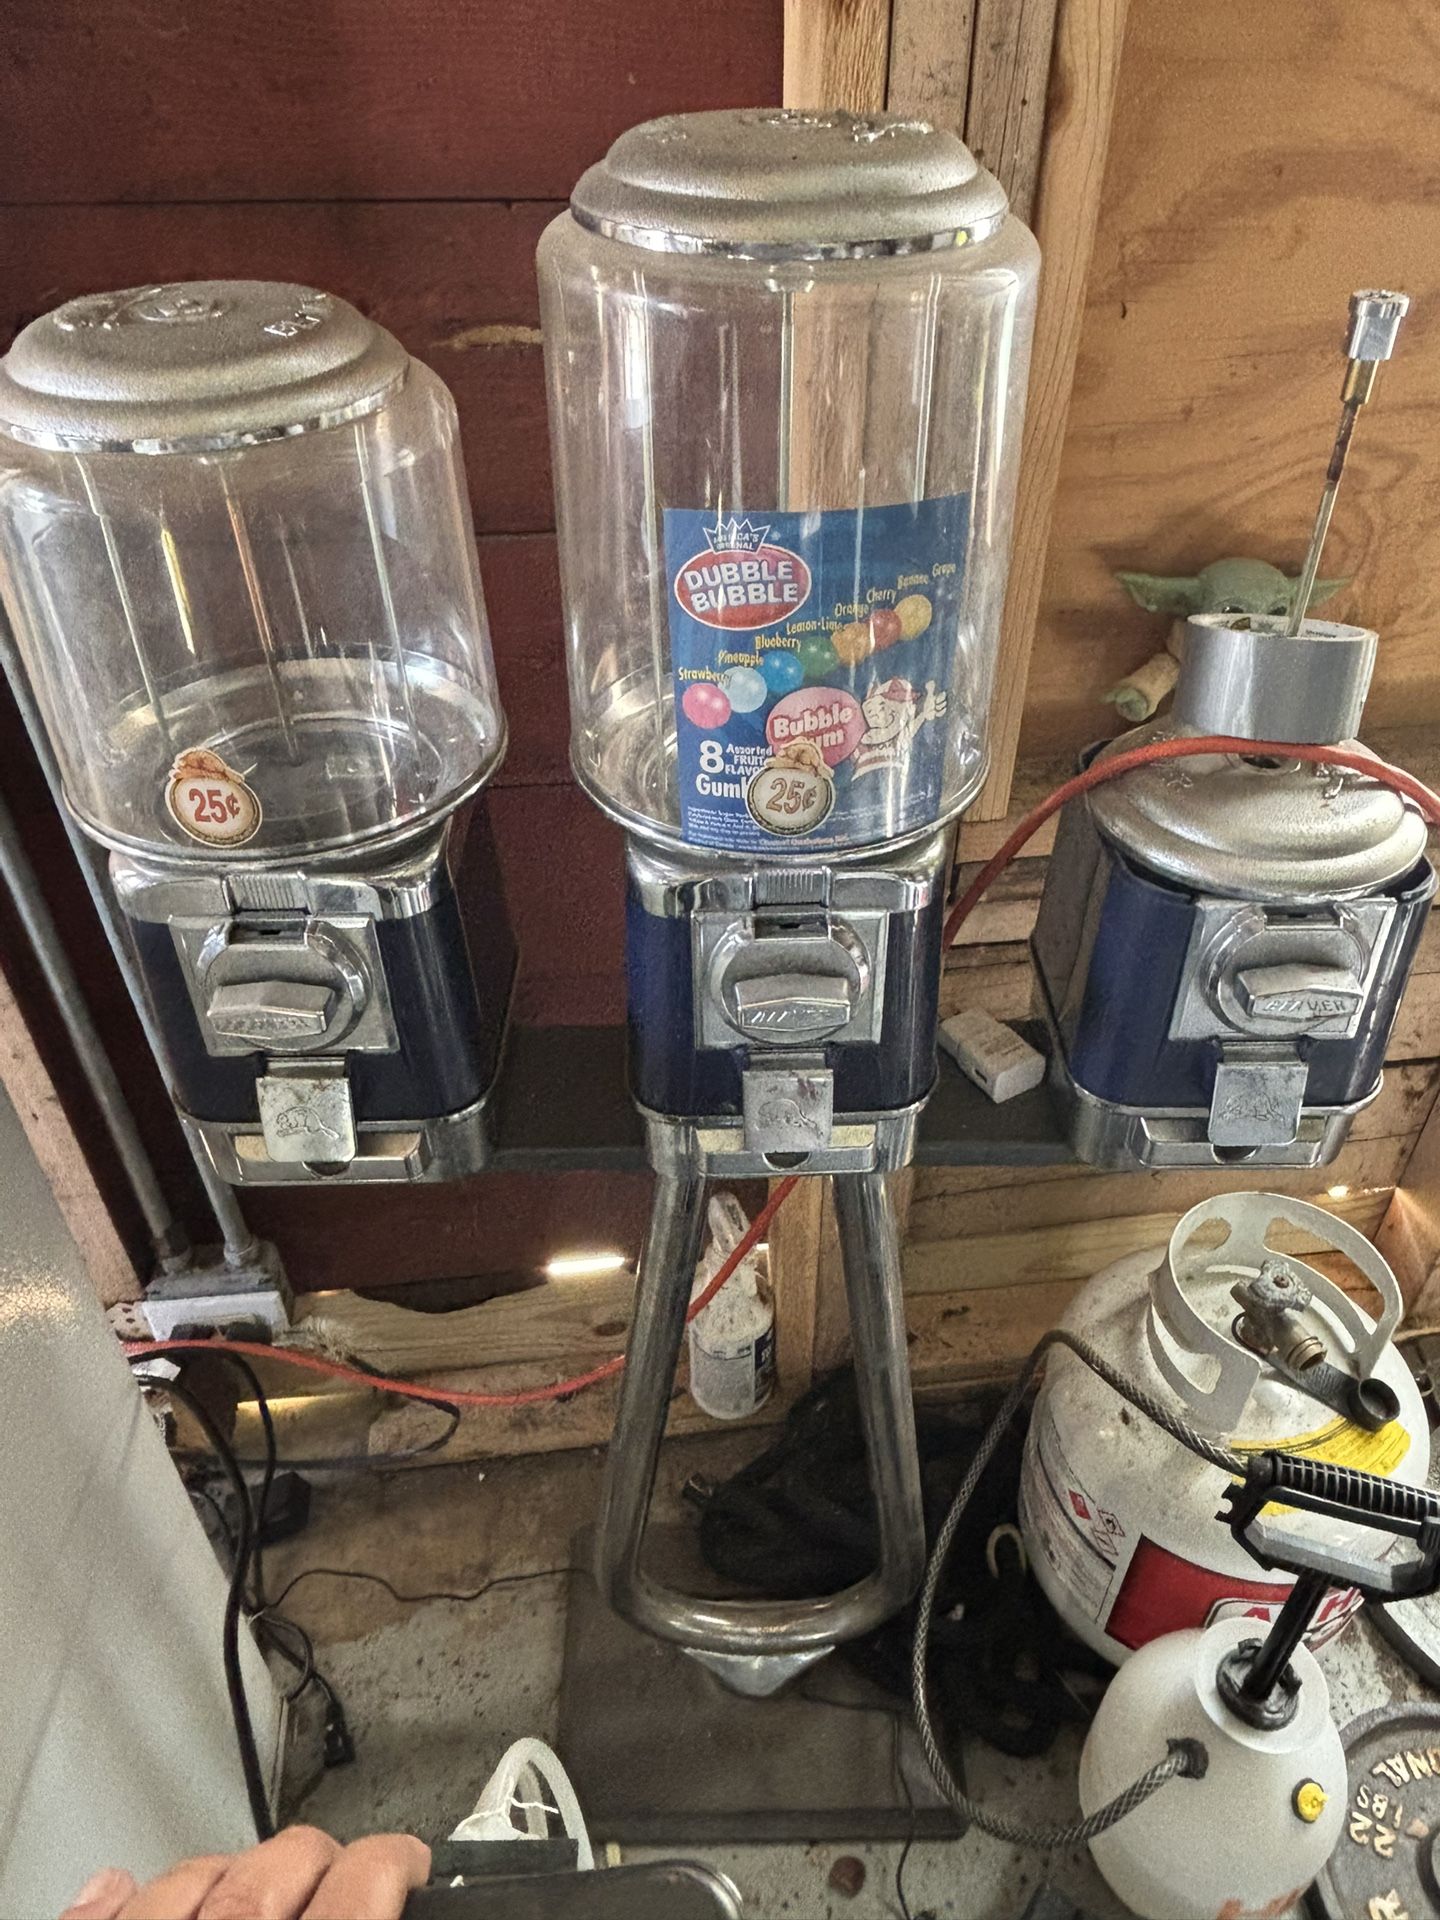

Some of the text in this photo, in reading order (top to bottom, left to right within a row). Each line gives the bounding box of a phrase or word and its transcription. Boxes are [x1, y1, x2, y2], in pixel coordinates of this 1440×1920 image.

[683, 560, 794, 591] DUBBLE
[690, 582, 799, 613] BUBBLE
[866, 586, 897, 604] Cherry
[834, 602, 870, 618] Orange
[754, 631, 802, 653] Blueberry
[717, 648, 765, 668] Pineapple
[678, 664, 733, 689] Strawberry
[773, 703, 854, 739] Bubble
[725, 742, 773, 757] Assorted
[812, 728, 846, 749] um
[699, 739, 725, 774] 8
[188, 787, 241, 824] 25¢
[765, 777, 818, 814] 25¢
